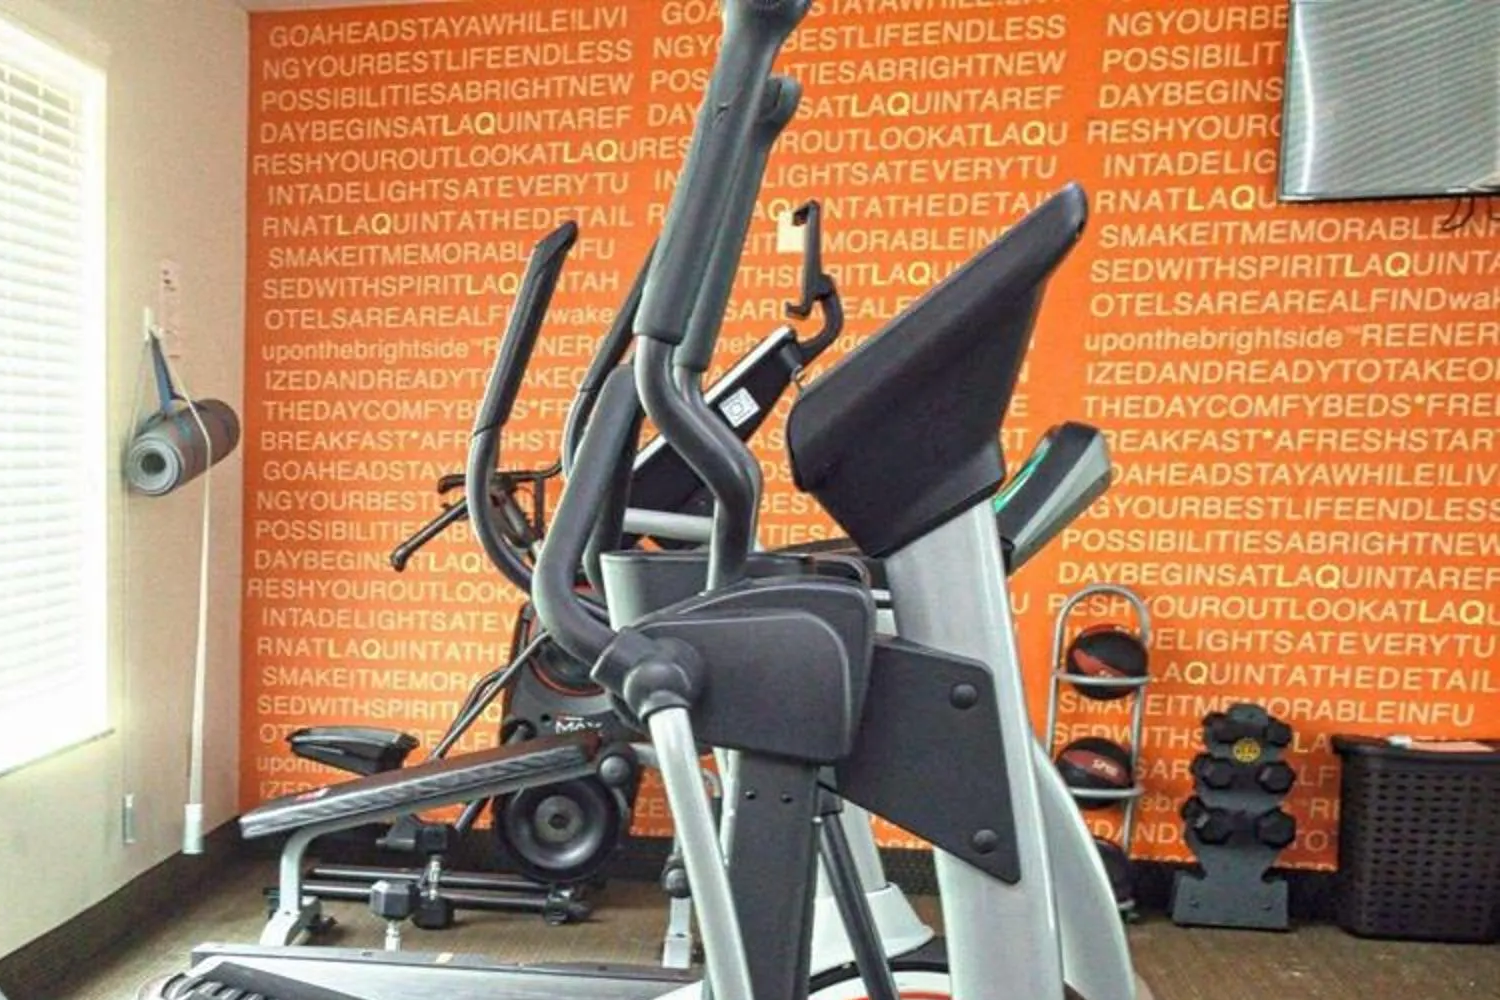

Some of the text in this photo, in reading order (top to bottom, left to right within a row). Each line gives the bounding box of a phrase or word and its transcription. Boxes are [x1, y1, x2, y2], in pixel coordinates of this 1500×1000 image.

[263, 39, 632, 80] NGYOURBESTLIFEENDLESS
[262, 73, 634, 112] POSSIBILITIESABRIGHTNEW
[260, 106, 633, 144] DAYBEGINSATLAQUINTAREF
[1087, 357, 1500, 385] IZEDANDREADYTOTAKEO
